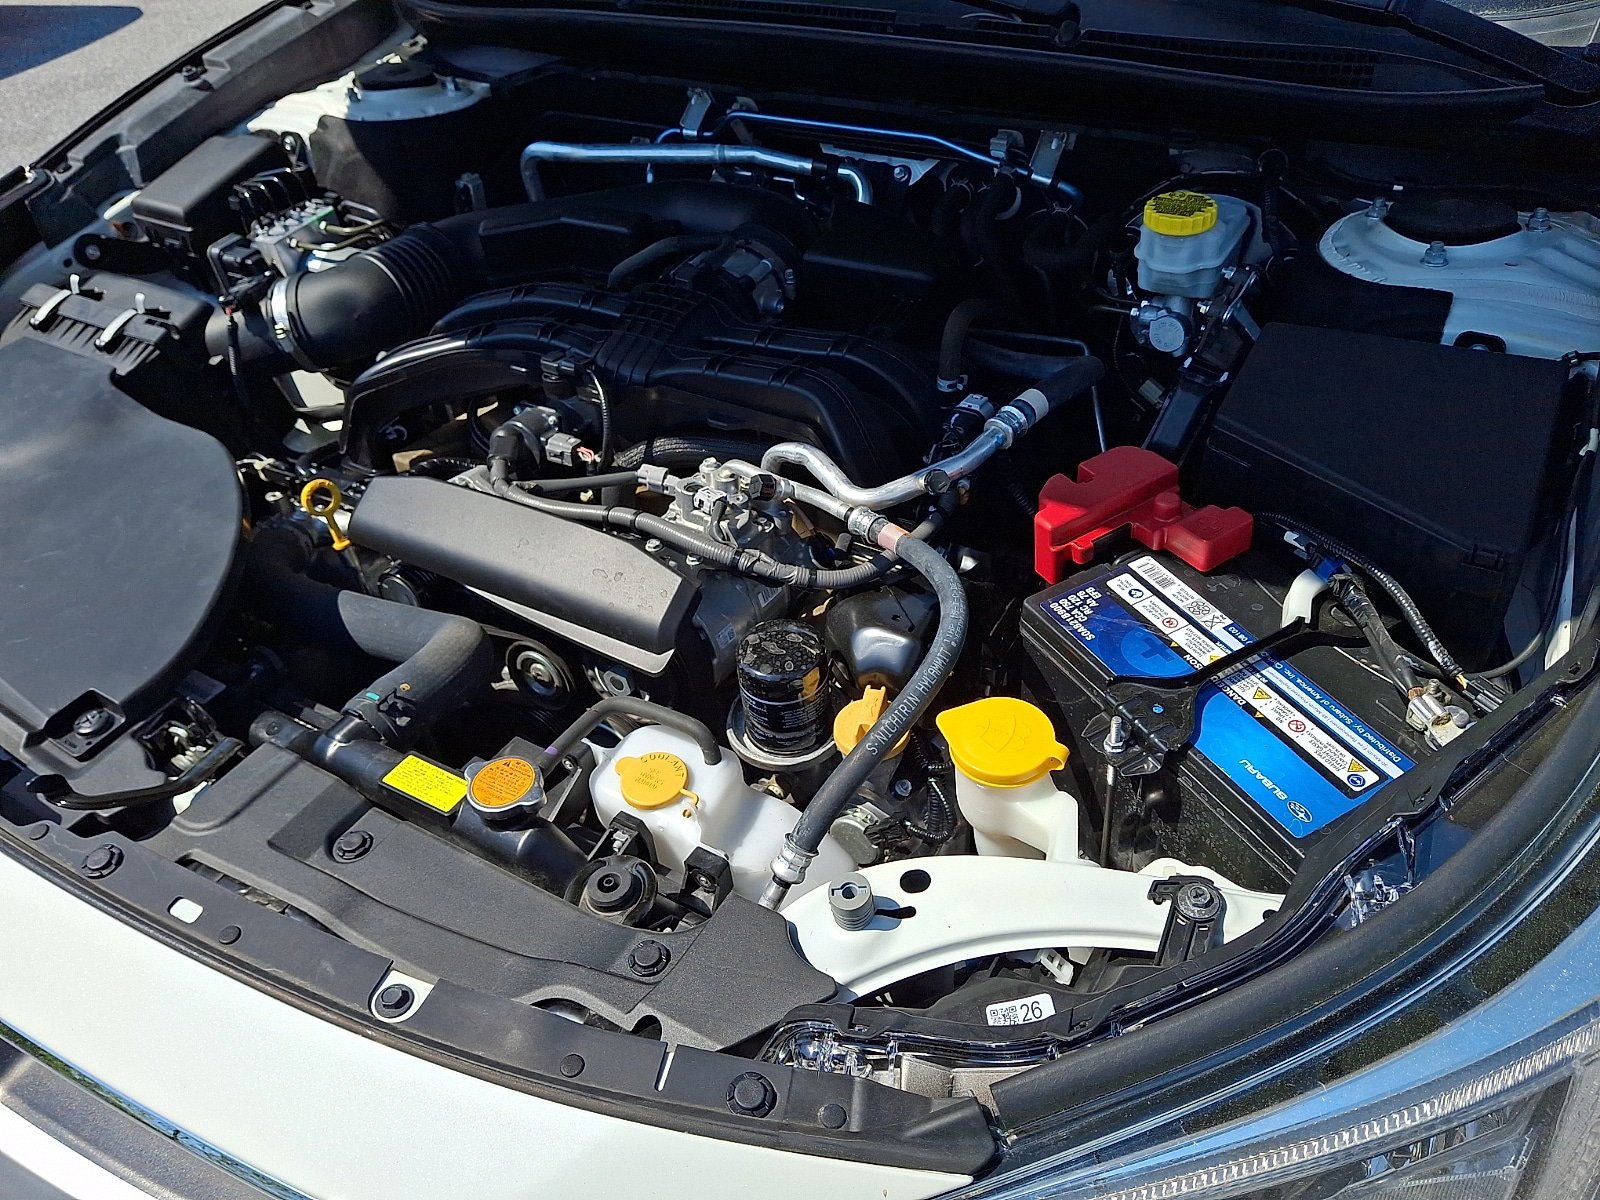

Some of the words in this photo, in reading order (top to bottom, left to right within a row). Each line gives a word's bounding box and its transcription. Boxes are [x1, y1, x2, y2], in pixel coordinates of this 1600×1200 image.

[1077, 591, 1090, 599] 76
[1086, 587, 1102, 599] EFB
[1059, 599, 1074, 610] 750
[1068, 595, 1083, 606] 120
[1086, 598, 1099, 606] Ah
[1071, 608, 1087, 622] CCA
[1080, 605, 1094, 615] RC
[1229, 627, 1248, 642] 08103
[916, 647, 951, 697] HYLAMMIT
[1284, 668, 1295, 679] Inc.
[1330, 704, 1353, 724] Subaru
[1353, 724, 1364, 734] by:
[1364, 733, 1401, 762] Distributed
[641, 754, 684, 778] COOLANT
[1239, 759, 1288, 800] SUBARU
[1020, 1001, 1042, 1022] 26
